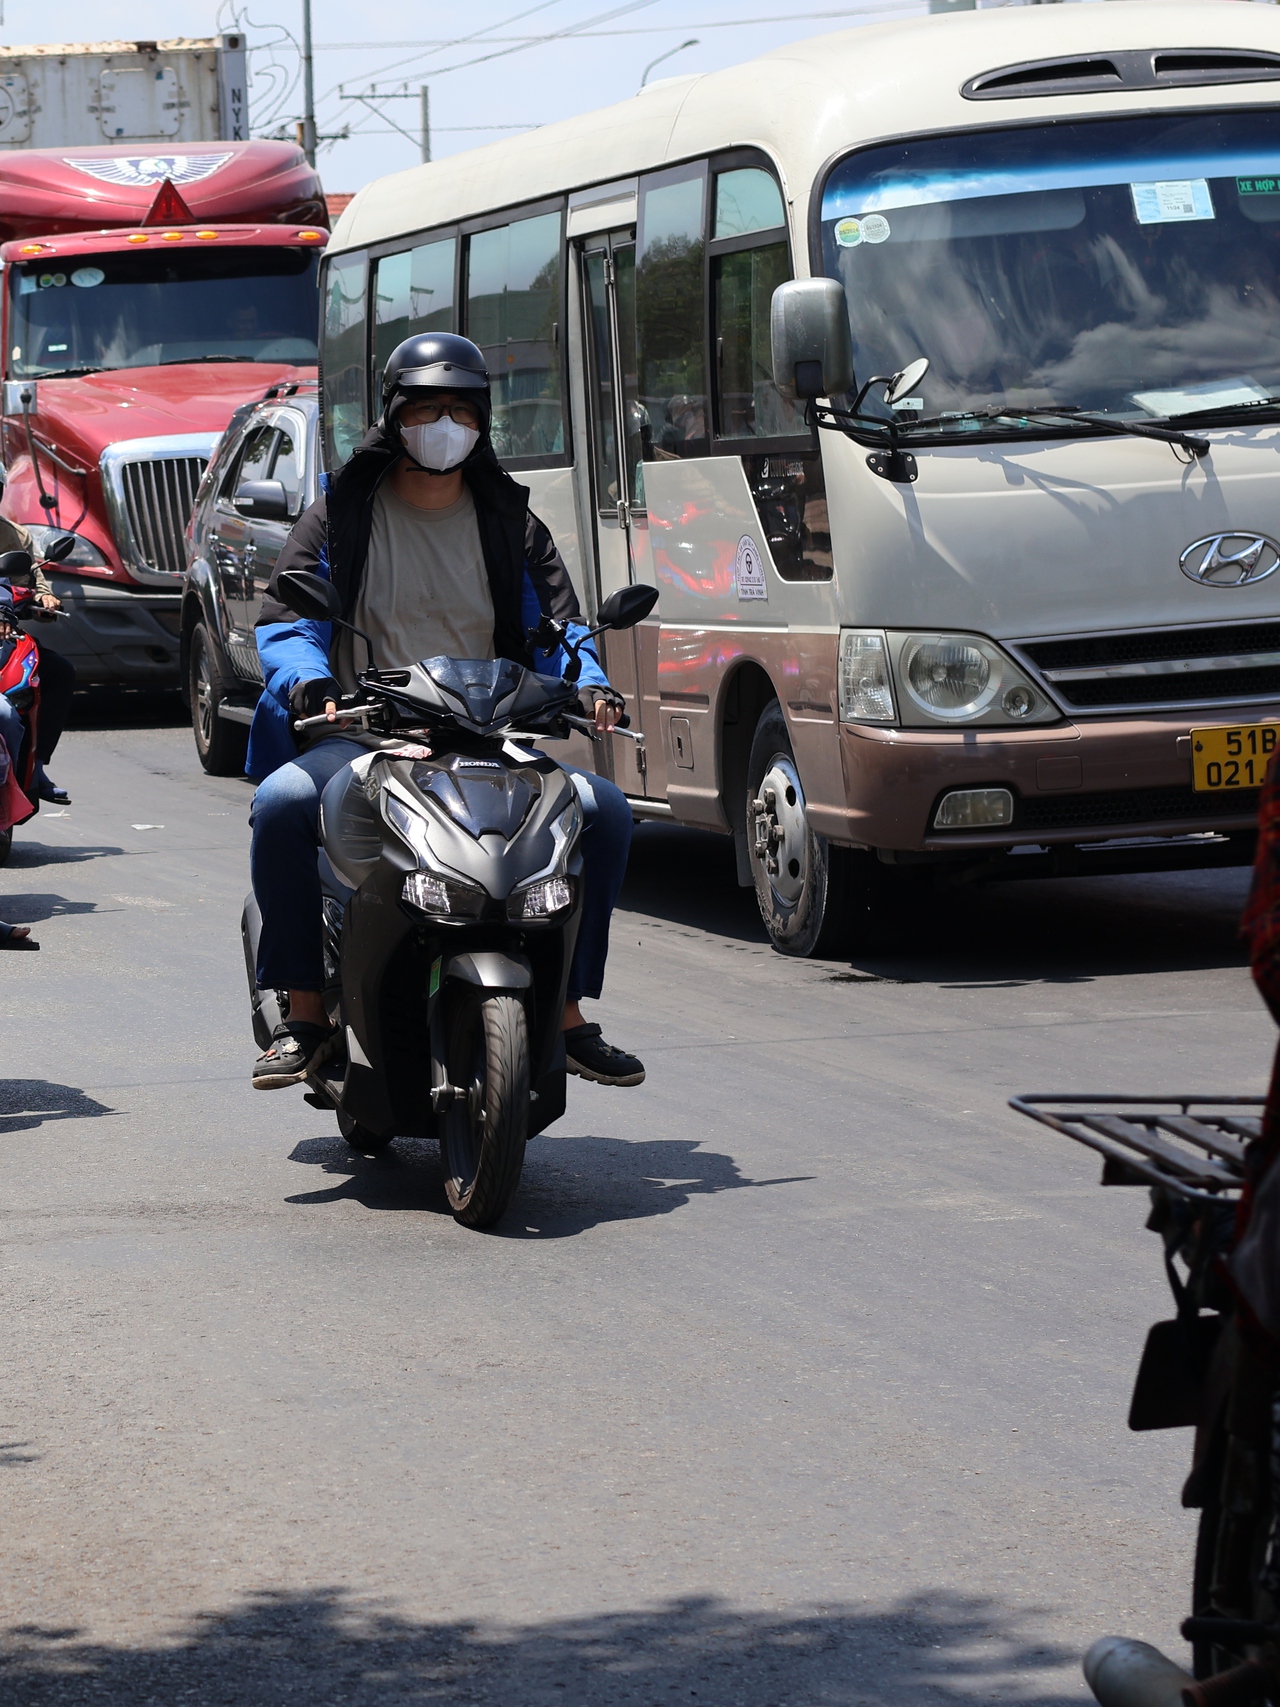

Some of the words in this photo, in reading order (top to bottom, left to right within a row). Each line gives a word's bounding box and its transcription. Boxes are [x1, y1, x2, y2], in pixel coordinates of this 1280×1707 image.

[1239, 180, 1253, 192] XE
[1254, 178, 1275, 193] HỢP
[1226, 728, 1277, 755] 51B
